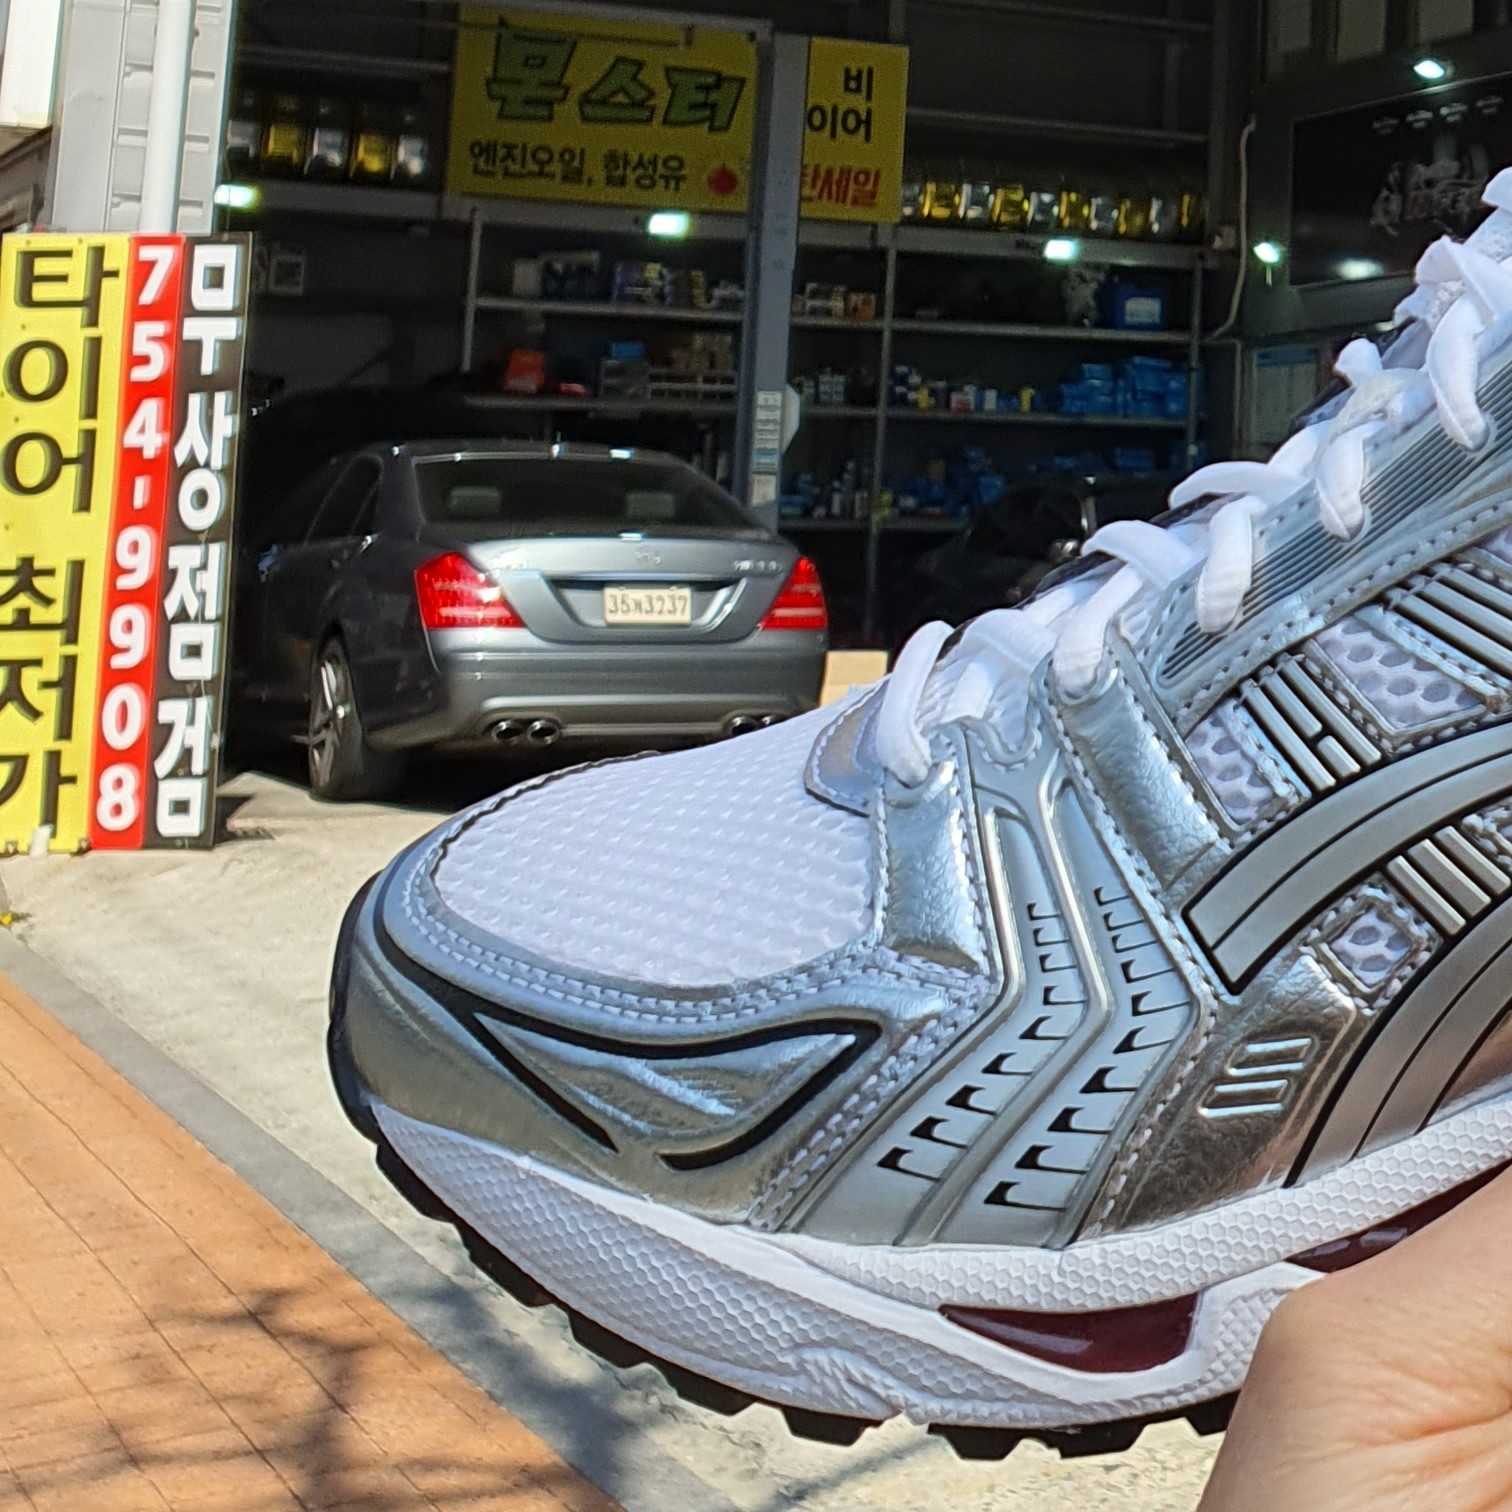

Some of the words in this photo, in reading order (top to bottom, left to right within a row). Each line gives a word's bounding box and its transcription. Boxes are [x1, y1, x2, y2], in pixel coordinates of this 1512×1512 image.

[486, 29, 747, 134] 몬스터
[0, 244, 120, 514] 타이어
[95, 244, 178, 833] 754-9908
[154, 244, 244, 837] 무상점검
